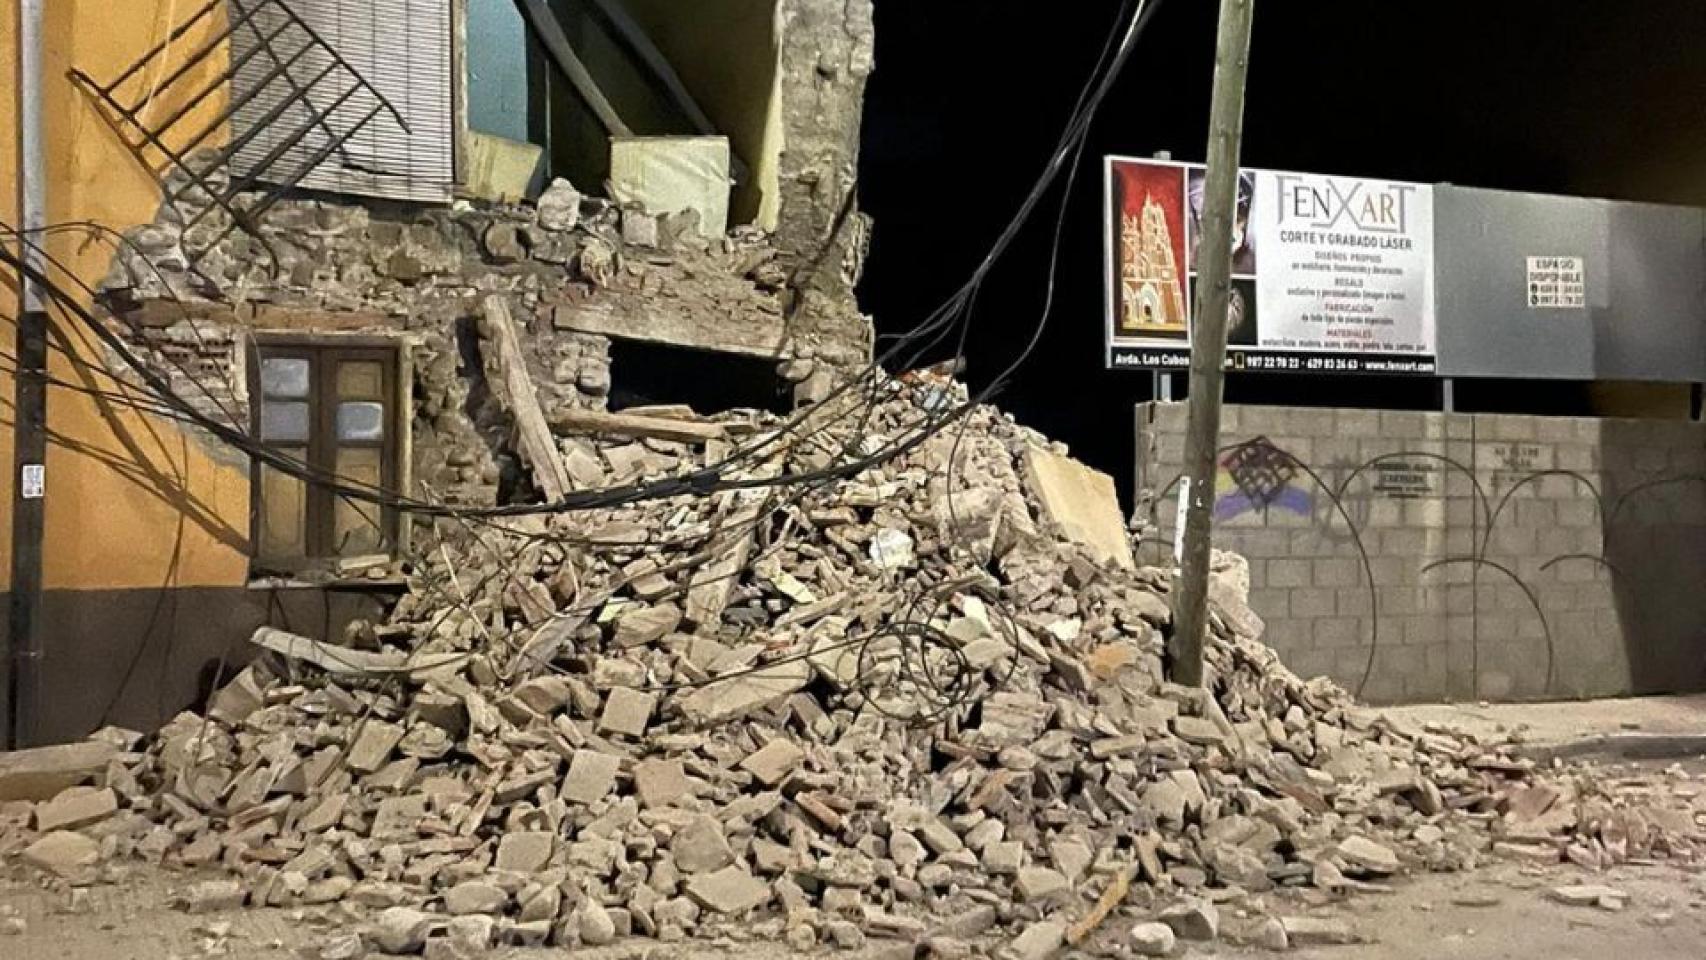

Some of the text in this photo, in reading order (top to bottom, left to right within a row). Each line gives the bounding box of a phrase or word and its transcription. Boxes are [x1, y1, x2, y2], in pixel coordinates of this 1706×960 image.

[1280, 231, 1412, 249] CORTE Y GRABADO LÁSER
[1115, 353, 1142, 365] Avda.
[1143, 354, 1159, 365] Los
[1161, 354, 1190, 365] Cubos
[1246, 356, 1262, 368] 987
